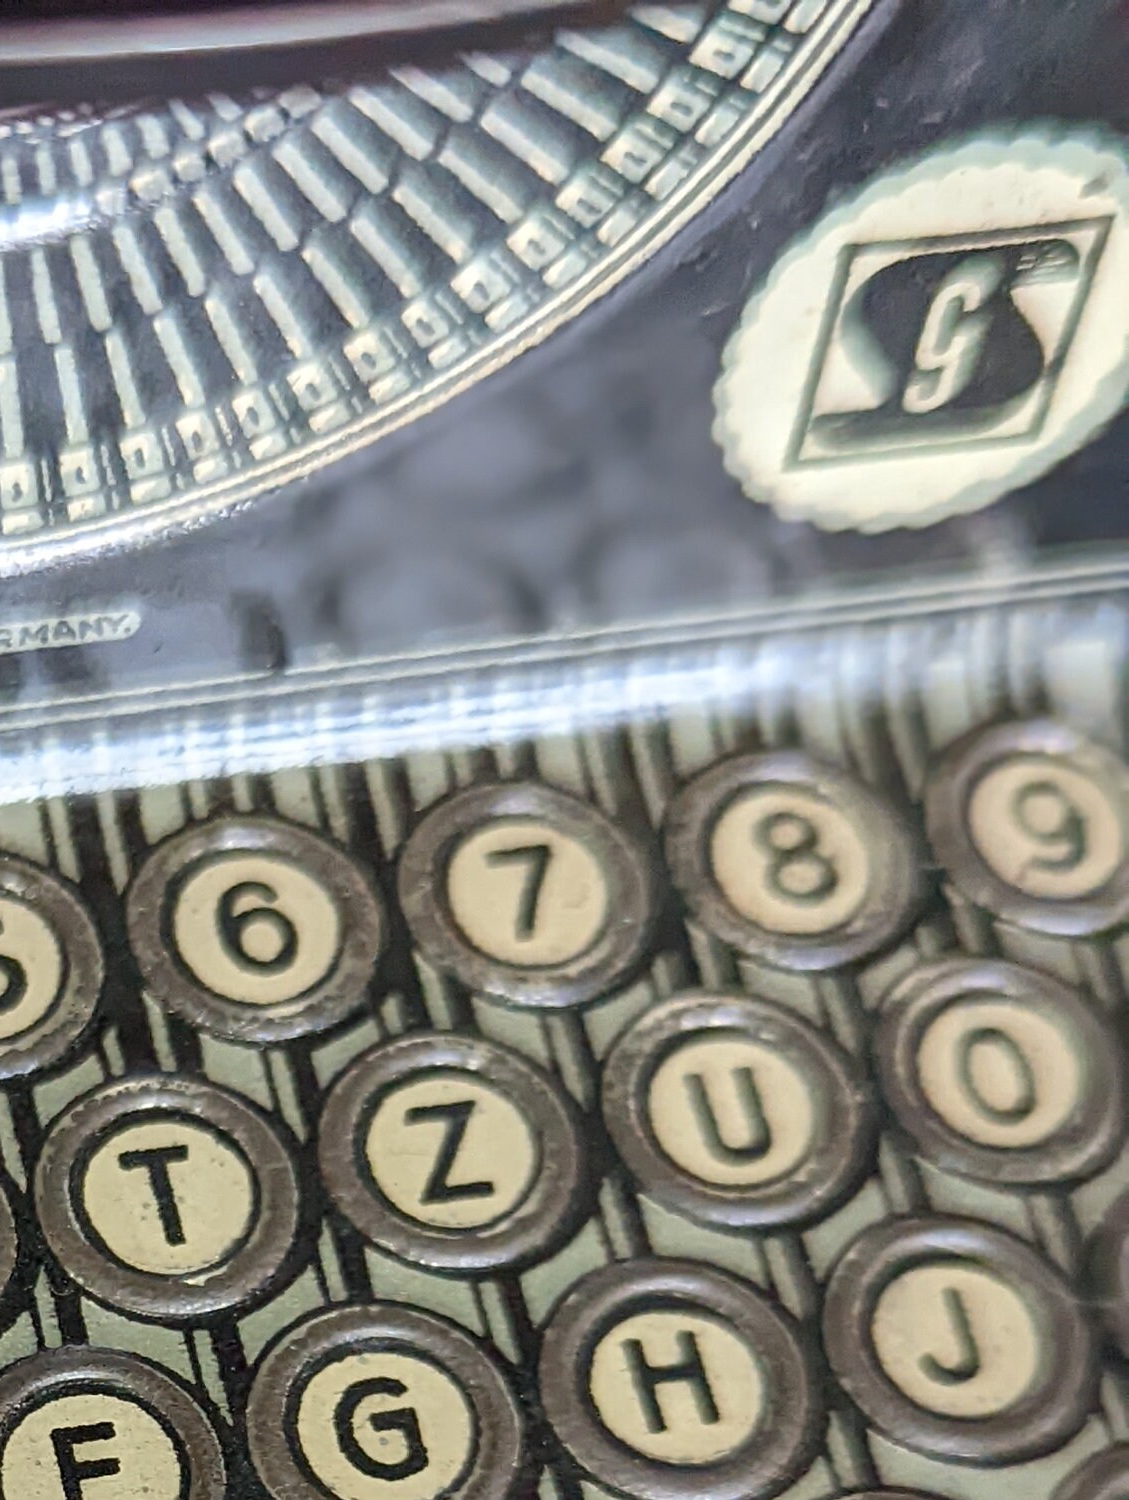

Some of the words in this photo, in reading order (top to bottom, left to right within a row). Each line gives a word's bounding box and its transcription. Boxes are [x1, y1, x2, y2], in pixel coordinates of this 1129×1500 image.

[215, 880, 299, 974] 6
[486, 843, 554, 939] 7
[755, 810, 841, 904] 8
[1014, 780, 1090, 873] 9
[118, 1145, 188, 1246] T
[405, 1100, 495, 1204] Z
[685, 1067, 774, 1166] U
[333, 1377, 429, 1481] G
[623, 1331, 721, 1433] H
[921, 1288, 983, 1385] J
